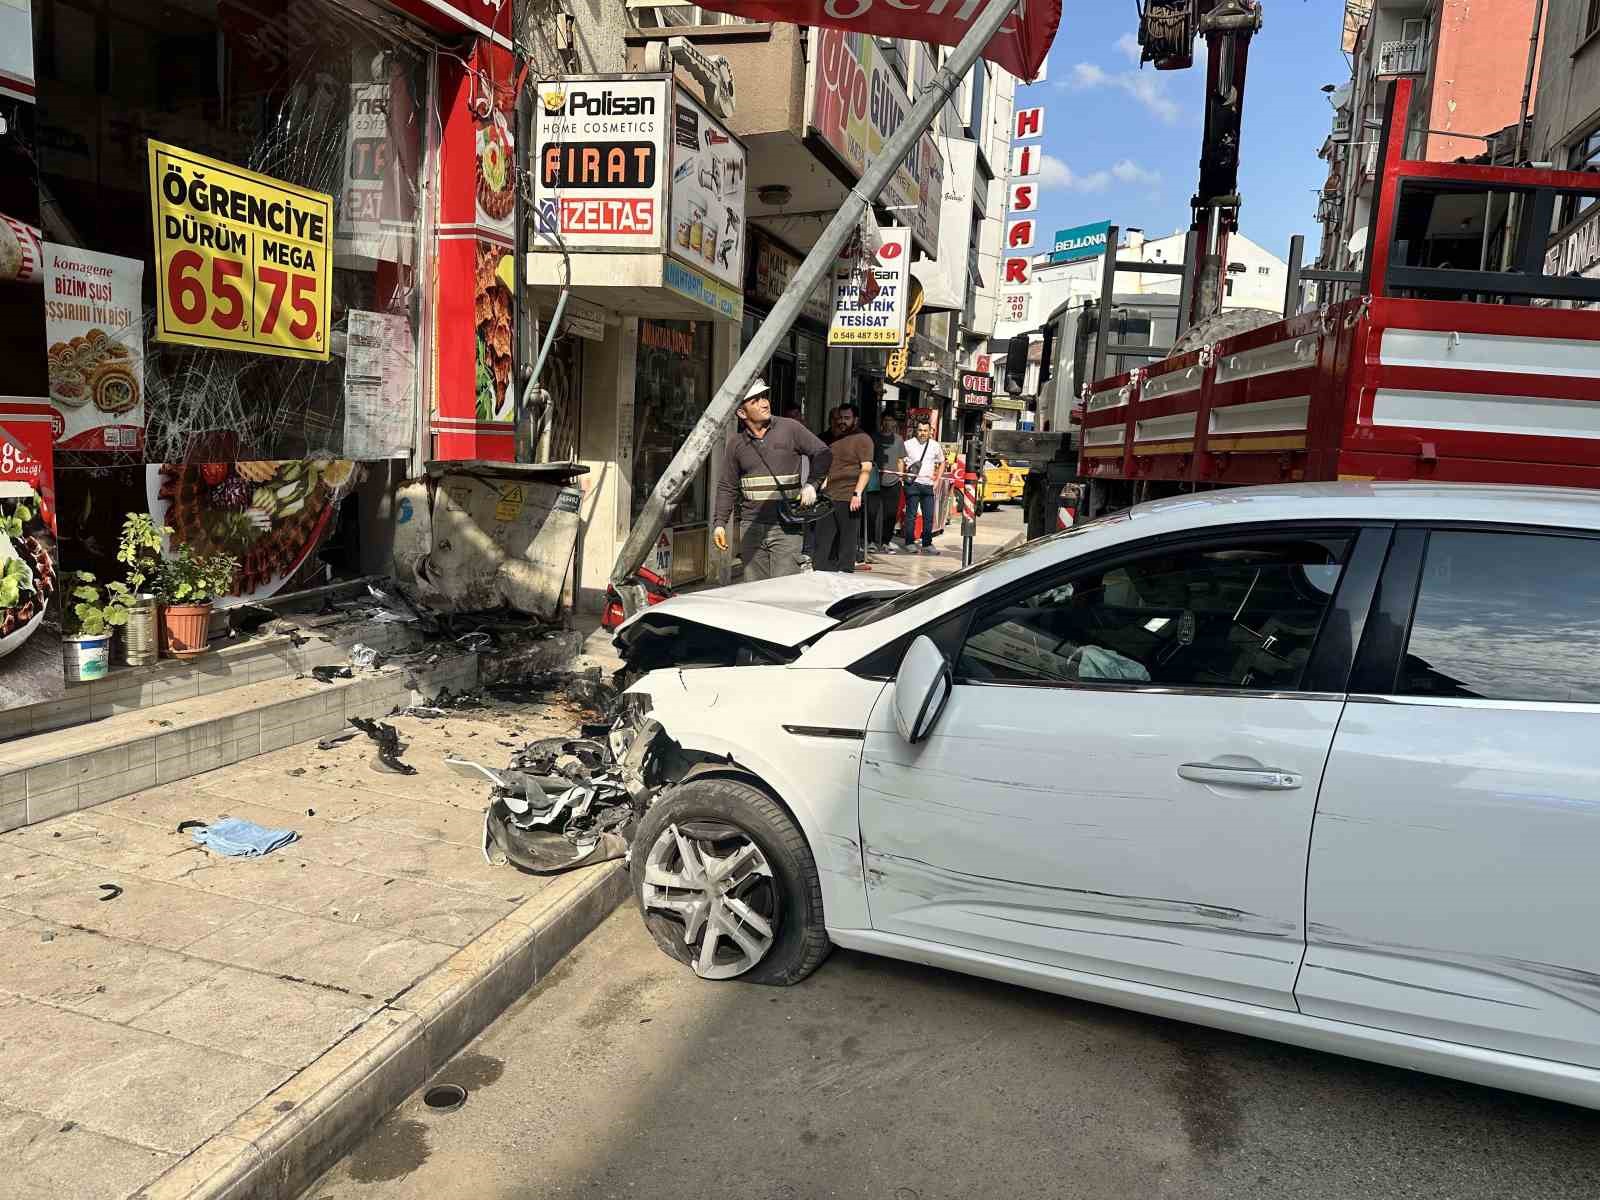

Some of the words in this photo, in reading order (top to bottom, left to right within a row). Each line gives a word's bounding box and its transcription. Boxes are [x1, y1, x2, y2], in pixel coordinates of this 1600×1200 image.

[569, 90, 655, 117] Polisan
[543, 122, 577, 134] HOME
[584, 121, 655, 134] COSMETICS
[545, 147, 651, 183] FIRAT
[162, 164, 324, 243] ÖĞRENCİYE
[165, 214, 246, 256] DÜRÜM
[262, 240, 316, 272] MEGA
[1055, 233, 1108, 253] BELLONA
[54, 255, 113, 277] komagene
[55, 275, 87, 298] BİZİM
[1006, 295, 1024, 303] 220
[840, 313, 889, 327] TESİSAT
[873, 331, 883, 340] 51
[885, 331, 896, 340] 51
[962, 374, 992, 393] OTEL
